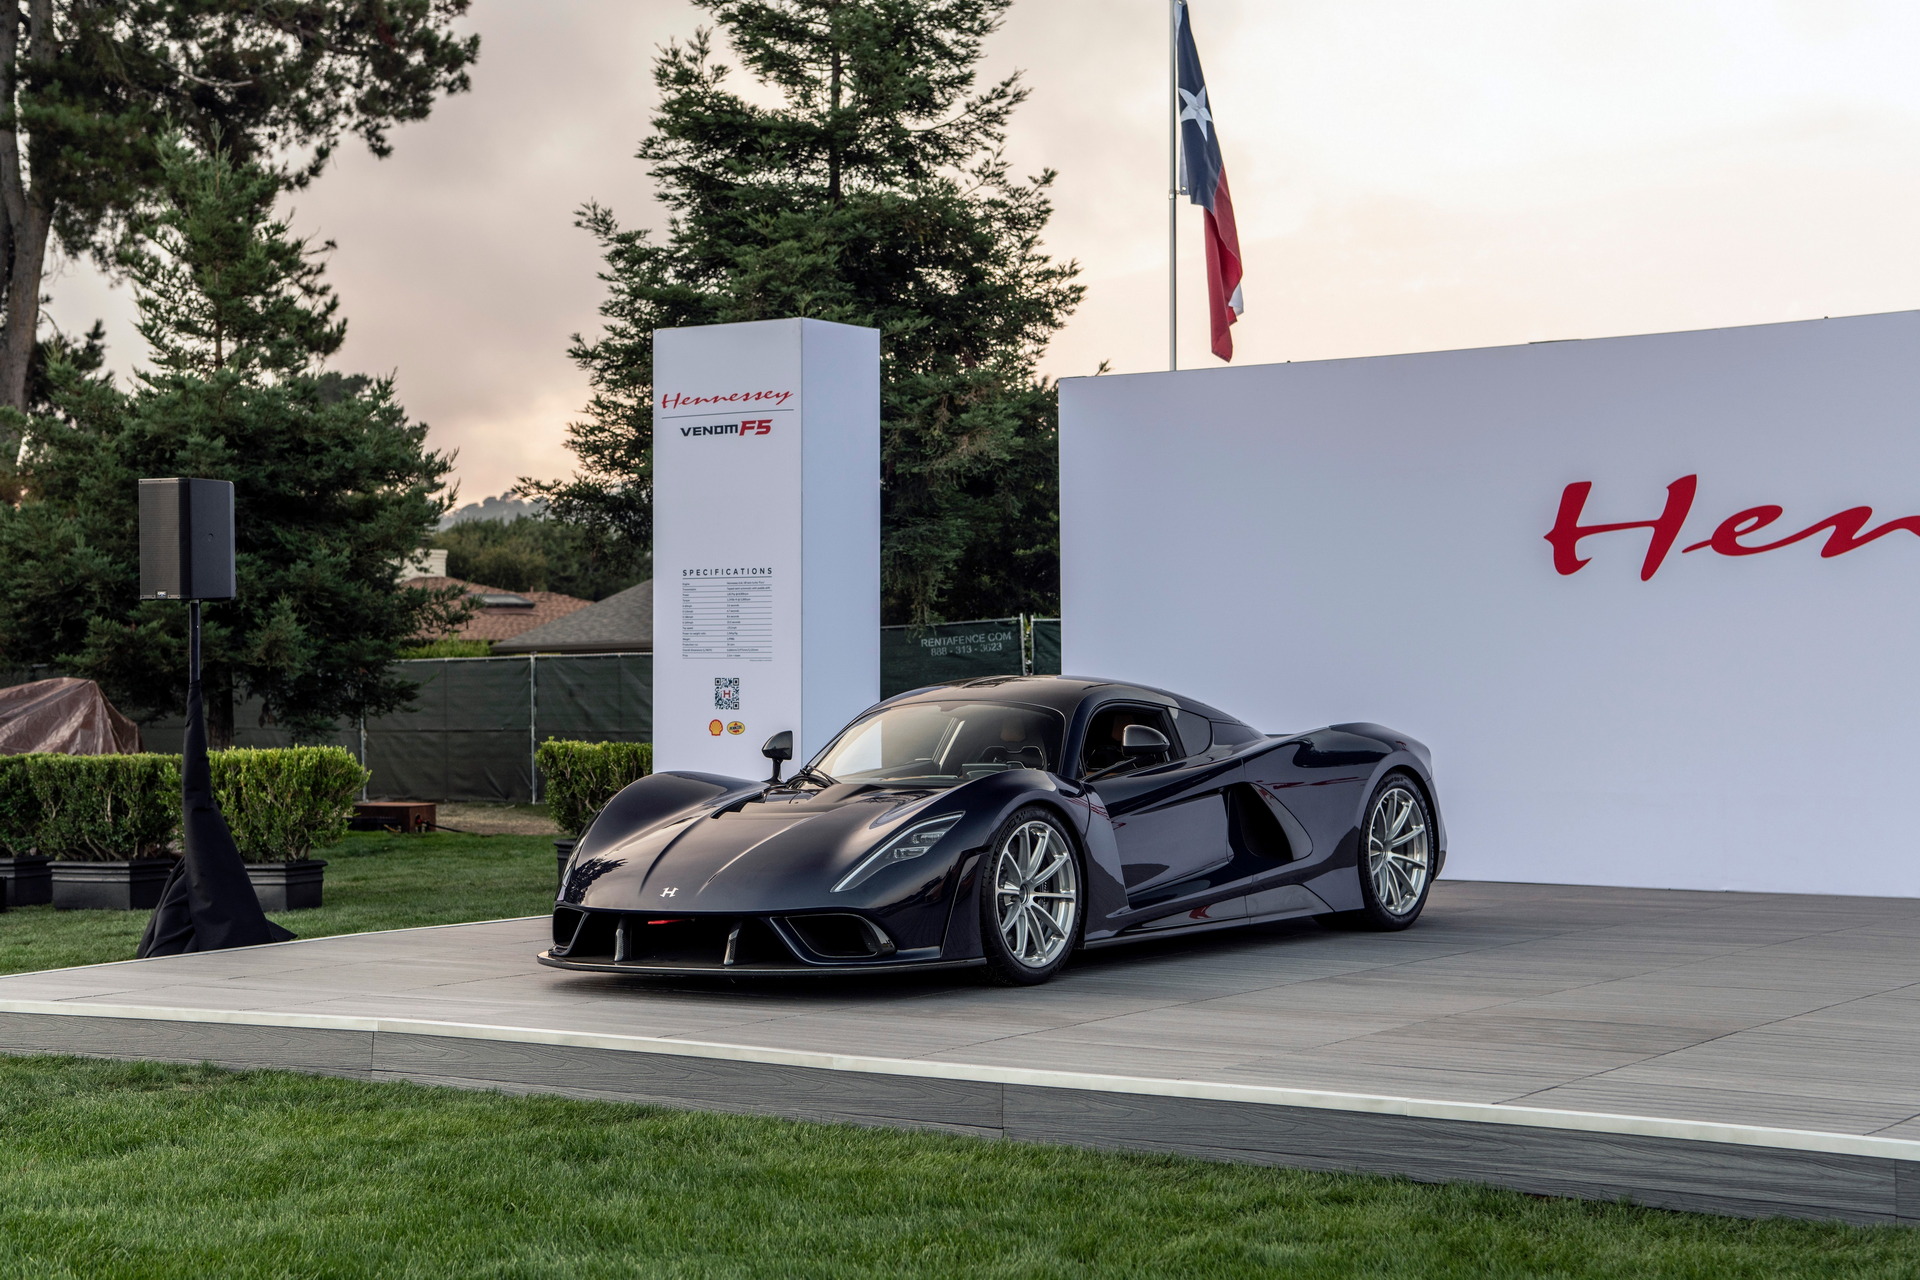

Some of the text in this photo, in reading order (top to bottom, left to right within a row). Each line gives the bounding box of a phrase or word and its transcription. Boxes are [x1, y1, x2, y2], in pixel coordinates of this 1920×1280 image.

[661, 390, 794, 409] Hennessey
[680, 424, 738, 437] VENOM
[682, 567, 772, 577] SPECIFICATIONS
